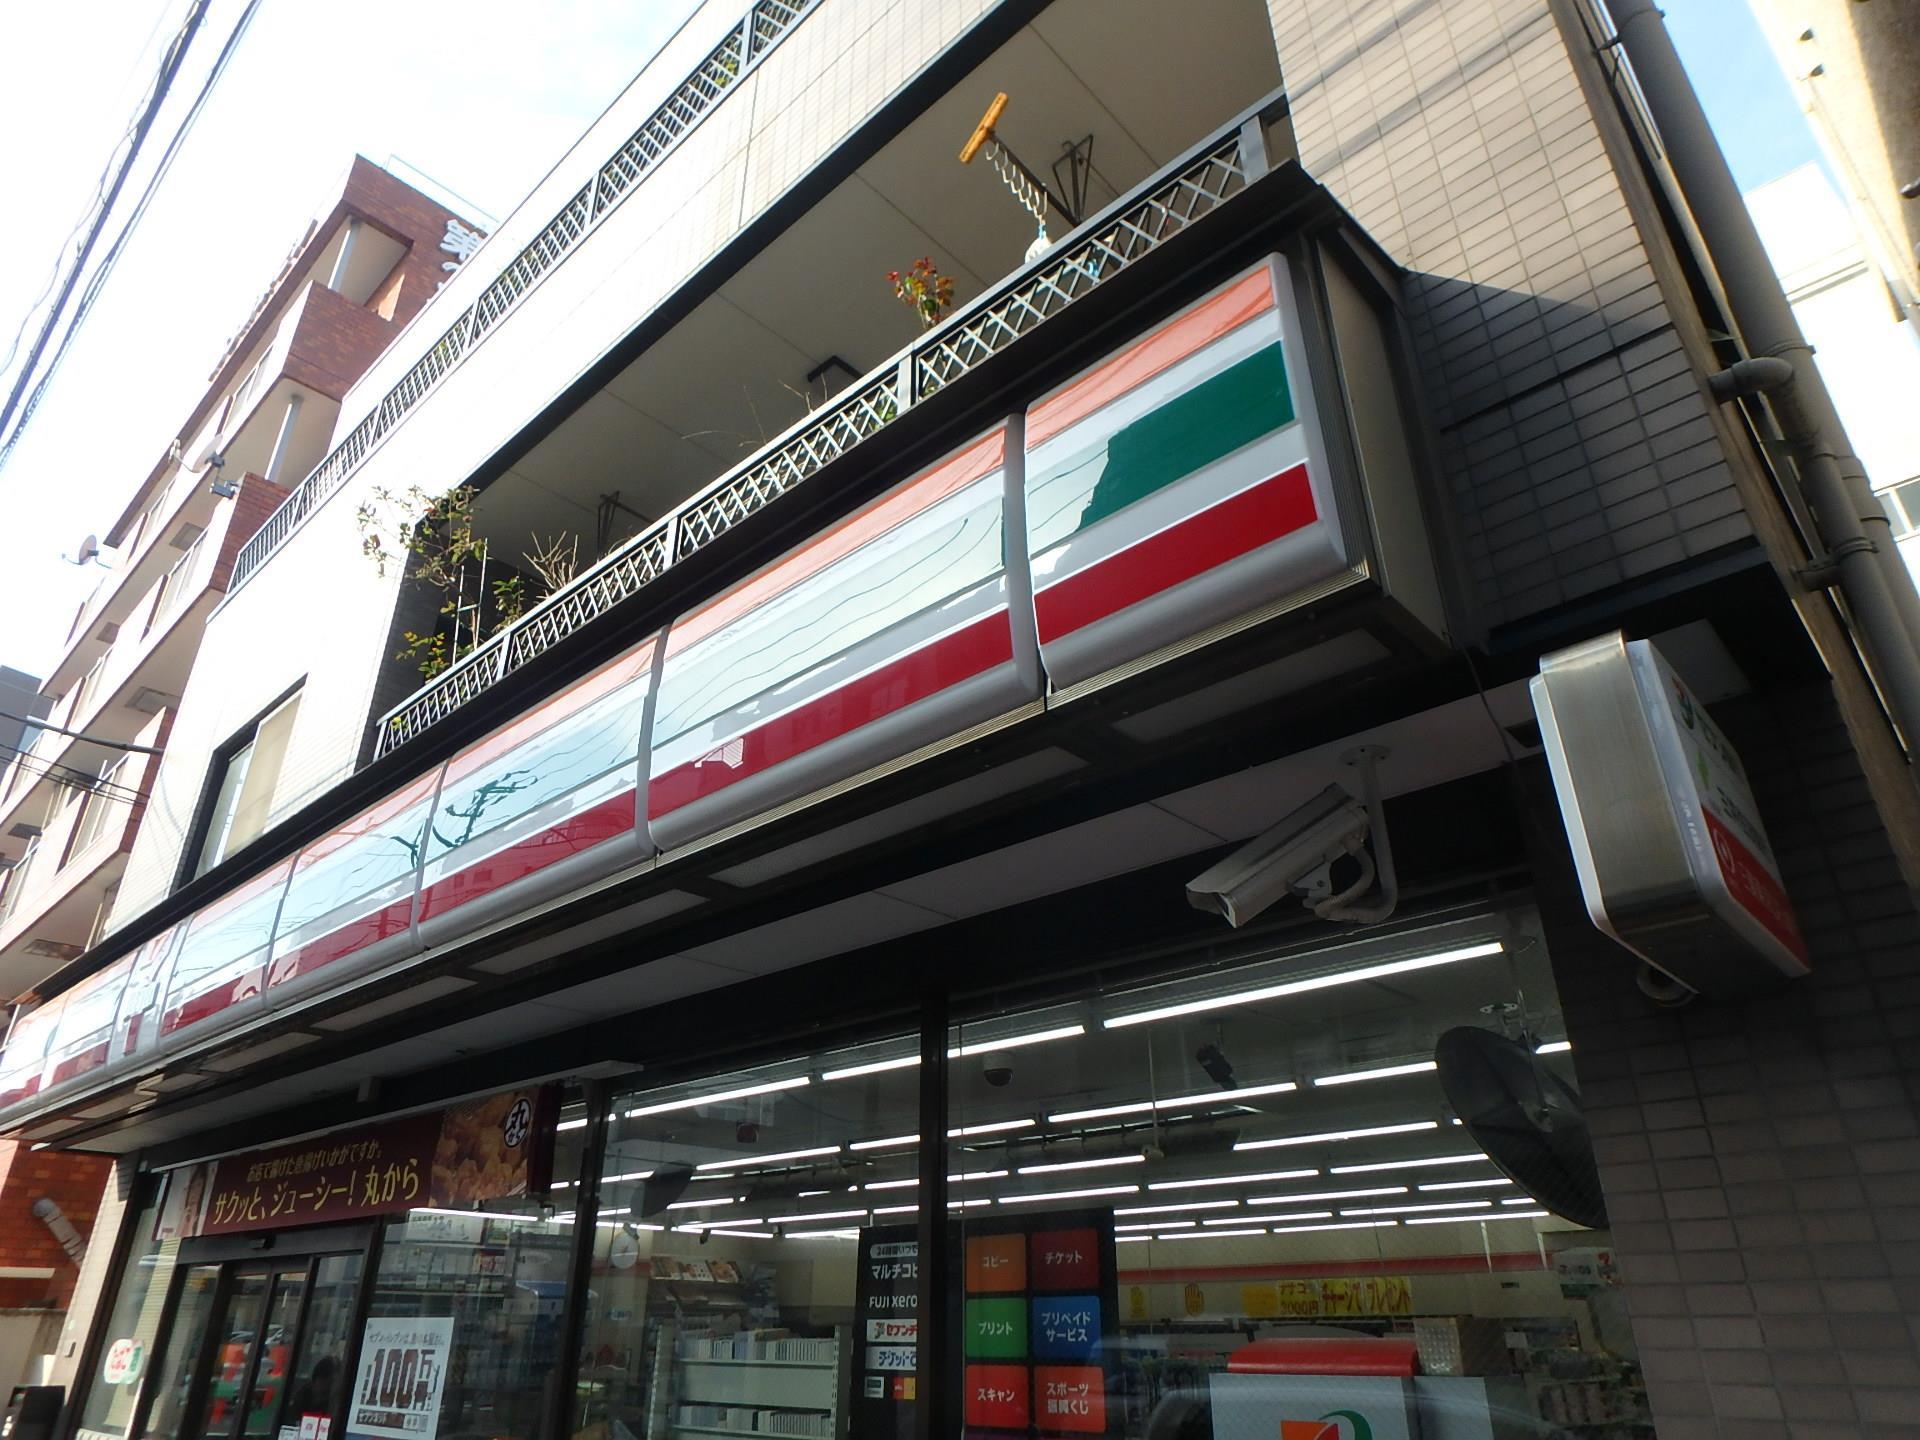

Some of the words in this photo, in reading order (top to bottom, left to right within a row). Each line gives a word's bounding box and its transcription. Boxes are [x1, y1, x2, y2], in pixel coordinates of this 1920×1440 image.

[982, 1256, 1009, 1268] コピー
[1045, 1250, 1083, 1265] チケット
[869, 1296, 890, 1308] FUJI
[1041, 1311, 1091, 1324] プリペイド
[978, 1321, 1013, 1336] プリント
[1045, 1328, 1088, 1343] サービス
[977, 1387, 1015, 1403] スキャン
[1047, 1382, 1089, 1395] スポーツ
